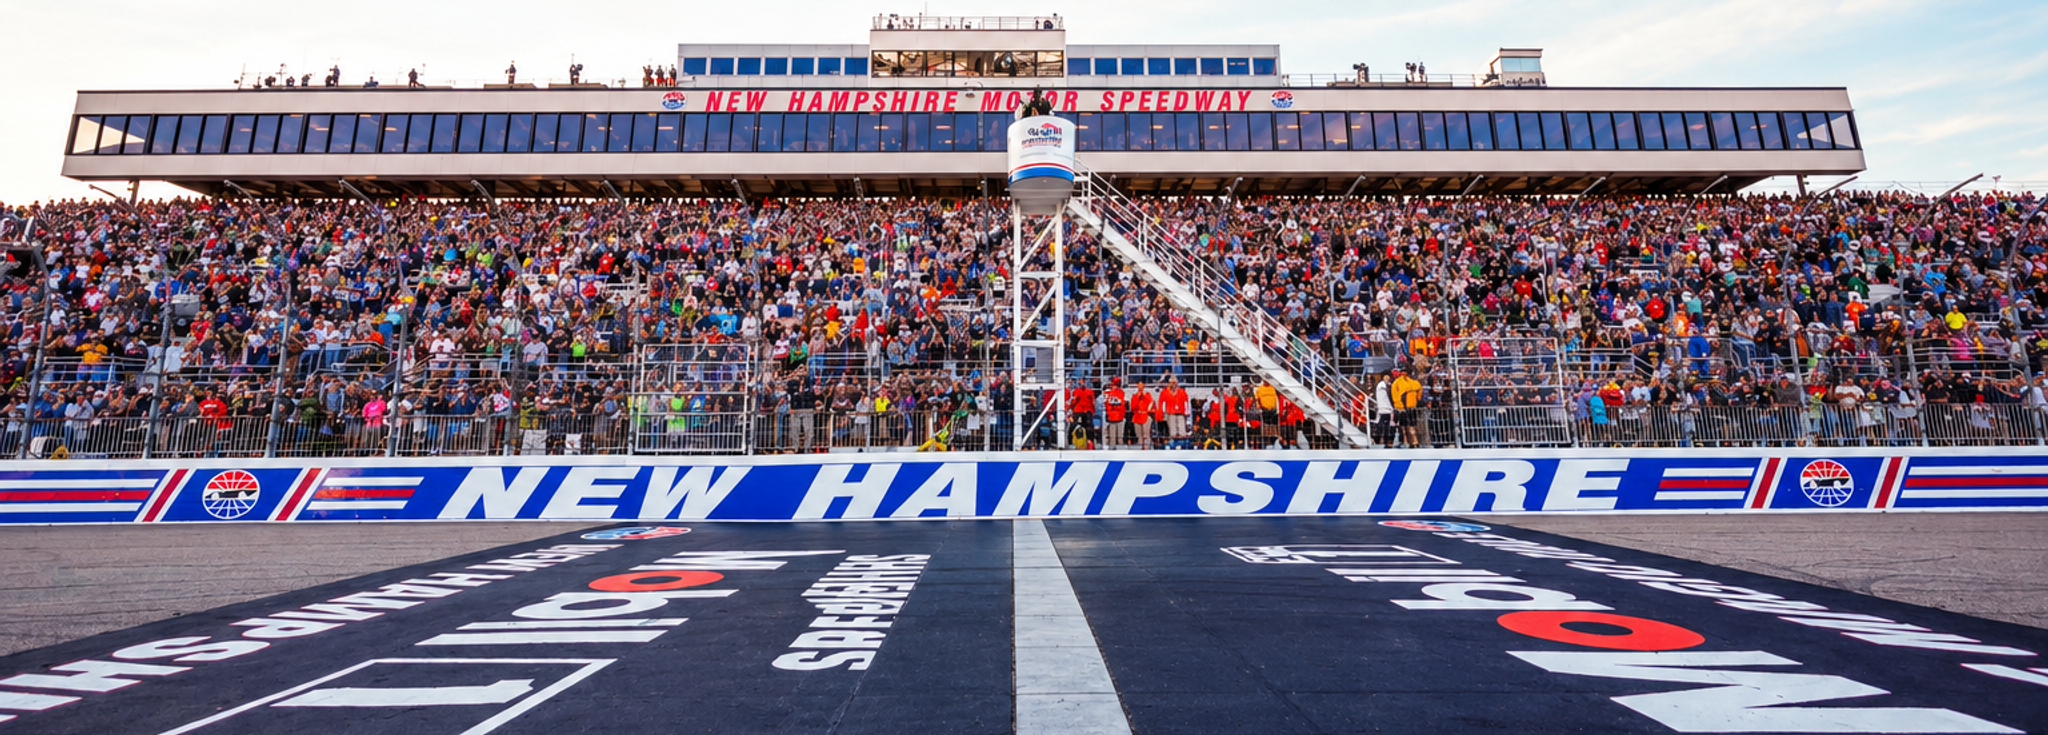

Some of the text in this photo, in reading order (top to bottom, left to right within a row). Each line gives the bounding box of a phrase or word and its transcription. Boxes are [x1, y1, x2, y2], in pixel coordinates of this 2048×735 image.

[706, 90, 1252, 112] NEW HAMPSHIRE MOOR SPEEDWAY
[439, 458, 1631, 520] NEW HAMPSHIRE
[414, 549, 846, 646] Mobil
[1324, 568, 2028, 735] Mobil
[269, 678, 536, 708] 1
